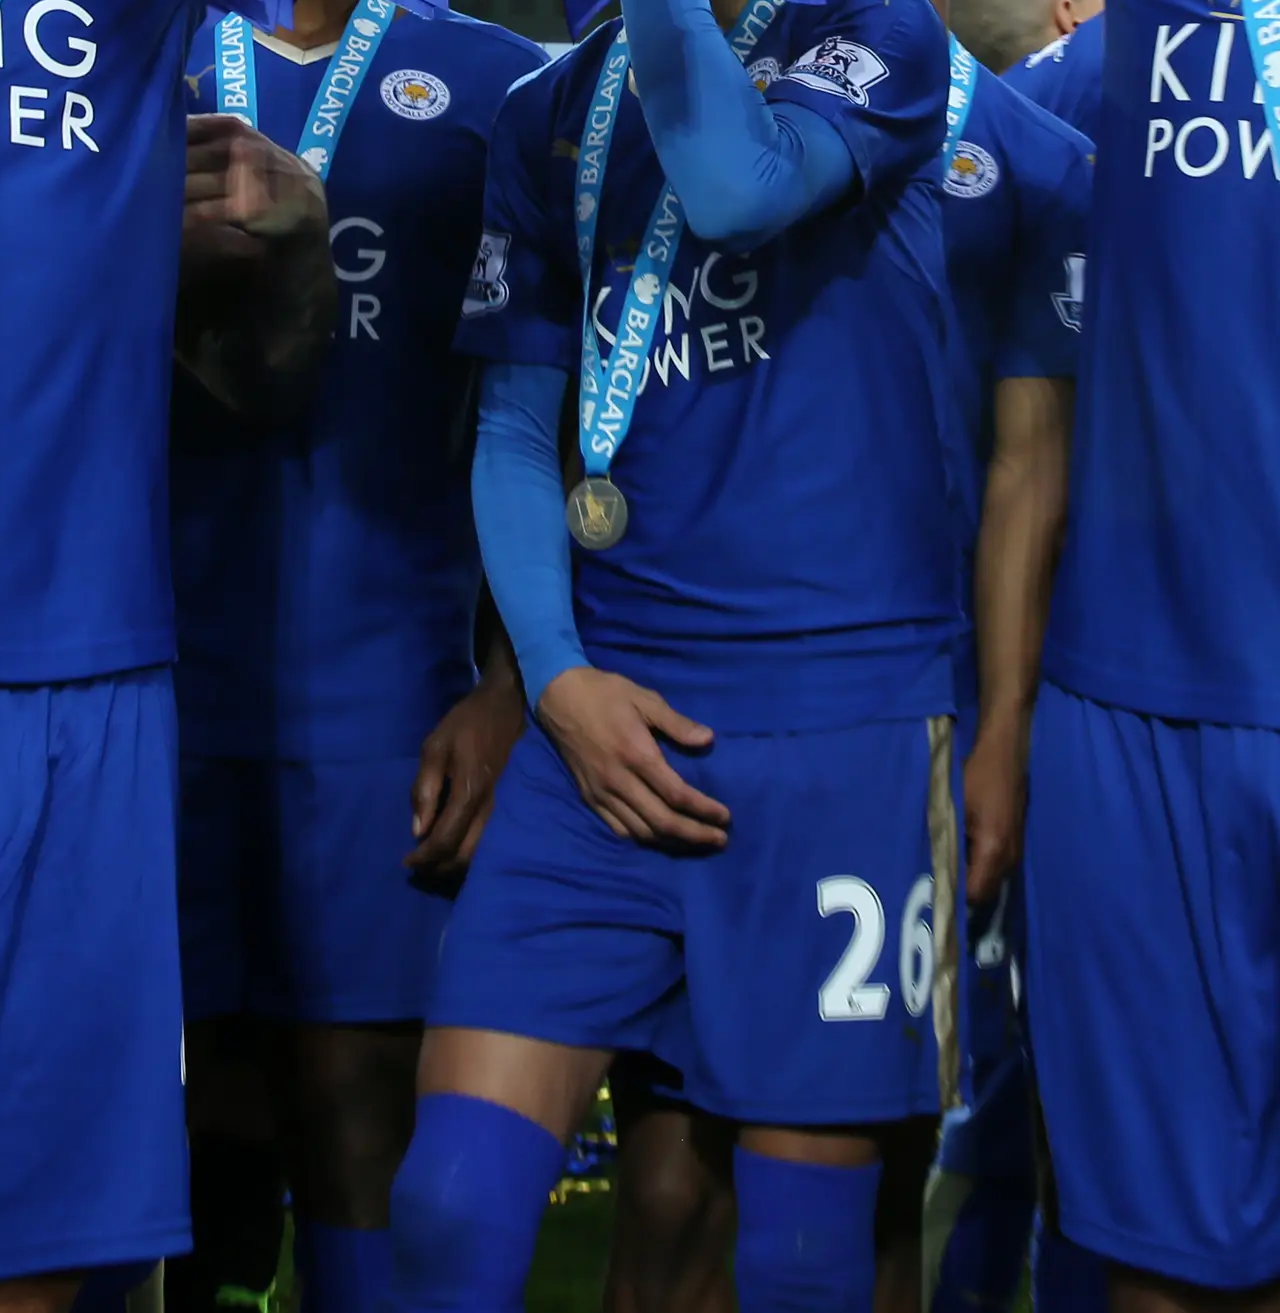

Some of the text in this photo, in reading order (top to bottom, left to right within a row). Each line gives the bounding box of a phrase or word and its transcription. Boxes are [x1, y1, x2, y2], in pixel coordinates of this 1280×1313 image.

[221, 14, 248, 108] BARCLAYS
[313, 34, 371, 138] BARCLAYS
[581, 54, 626, 185] BARCLAYS
[591, 306, 650, 458] BARCLAYS
[817, 873, 935, 1022] 26
